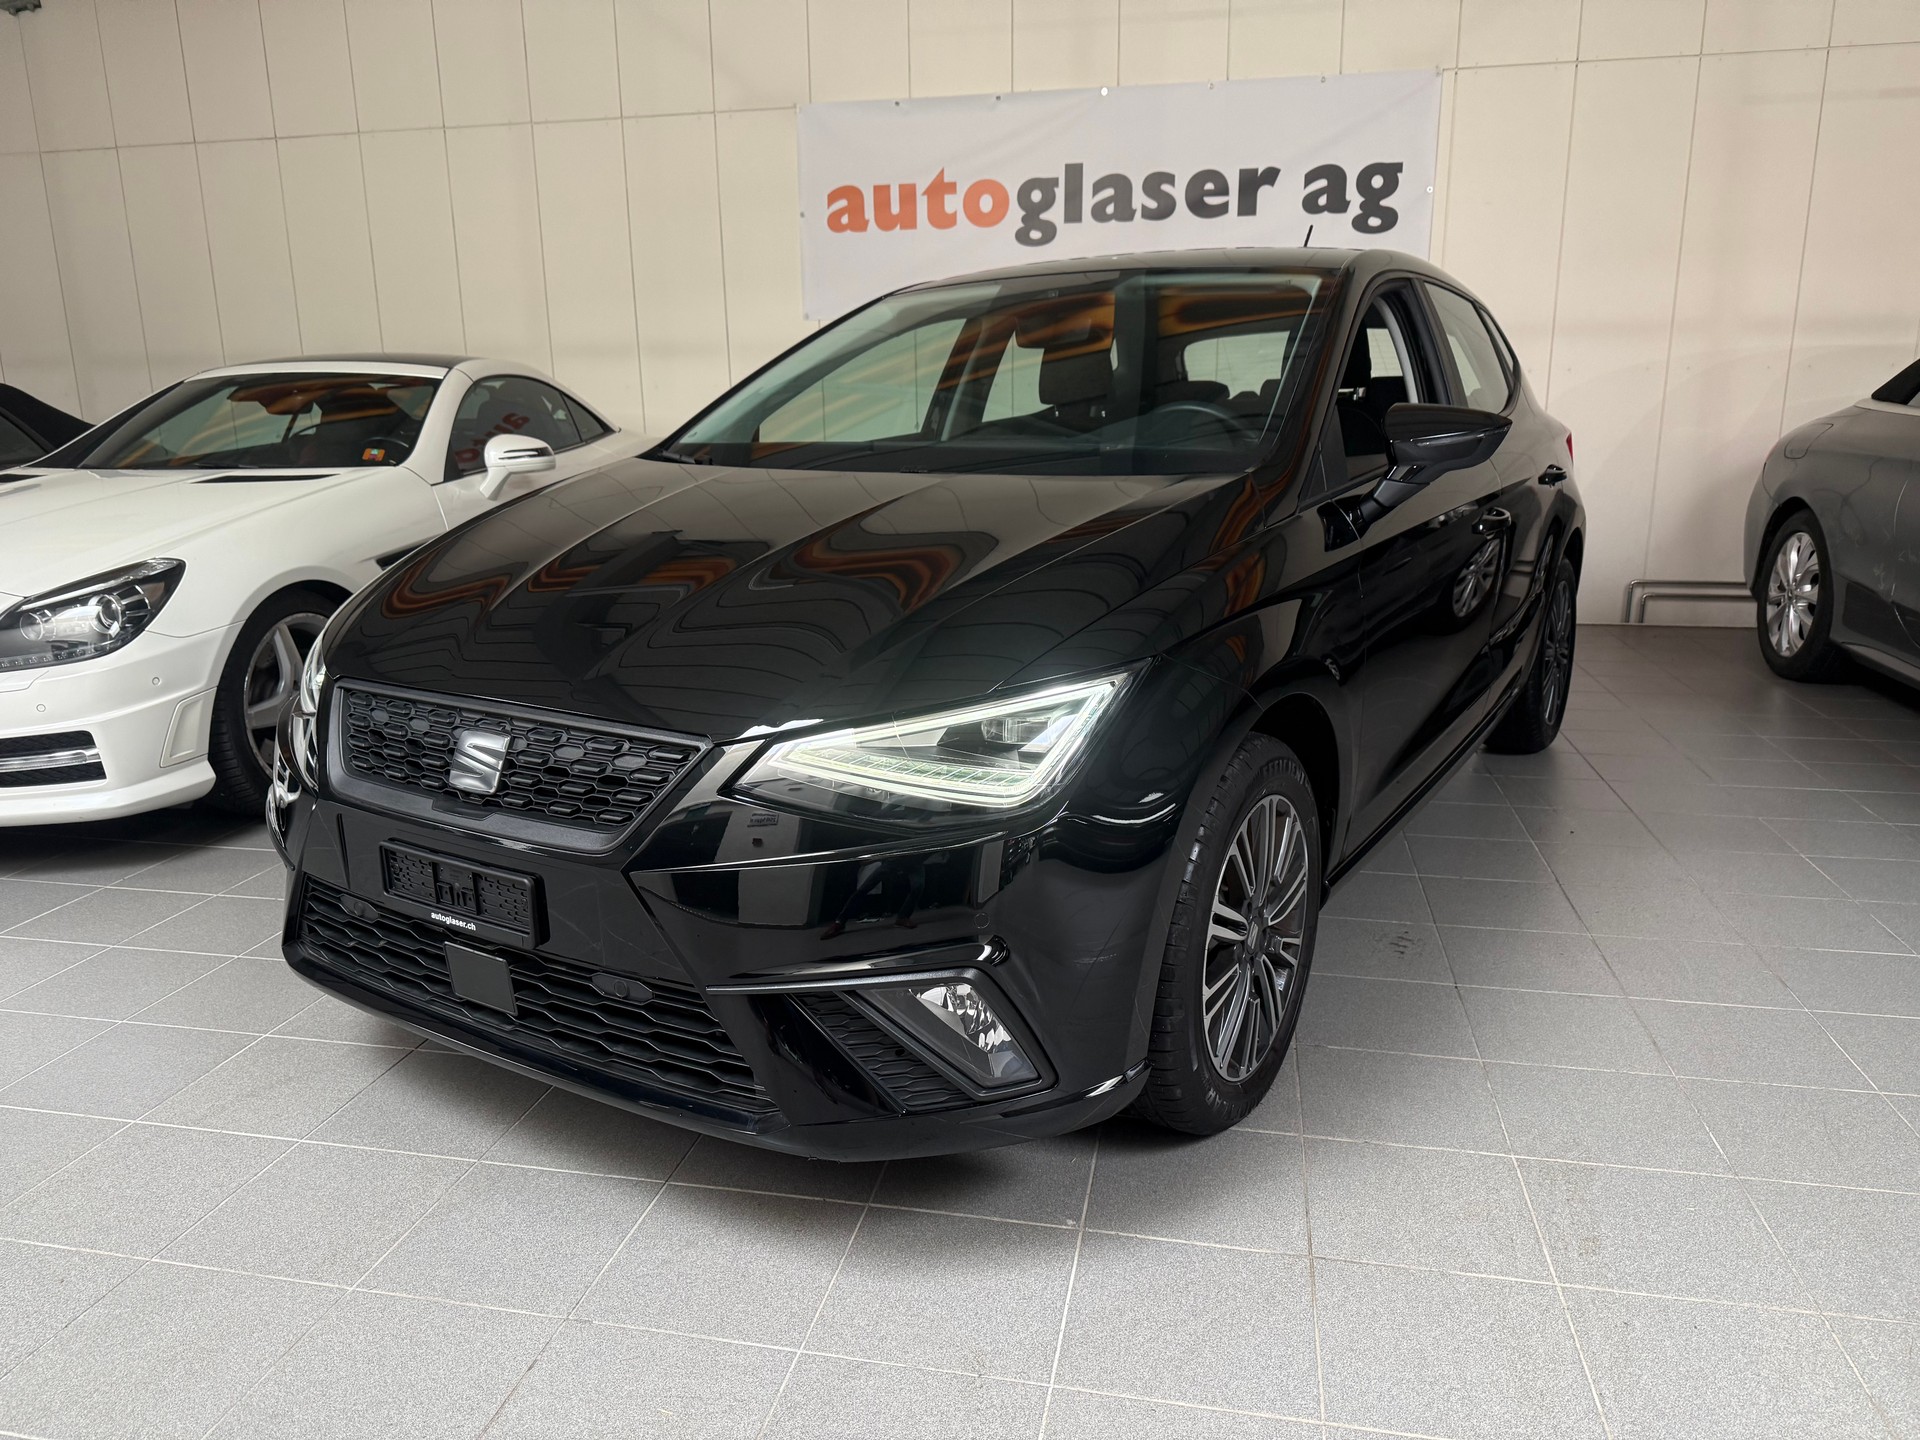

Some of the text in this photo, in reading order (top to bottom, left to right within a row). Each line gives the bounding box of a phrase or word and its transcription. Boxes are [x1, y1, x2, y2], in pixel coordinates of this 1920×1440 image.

[826, 161, 1404, 247] autoglaser ag
[430, 911, 477, 932] autoglaser.ch
